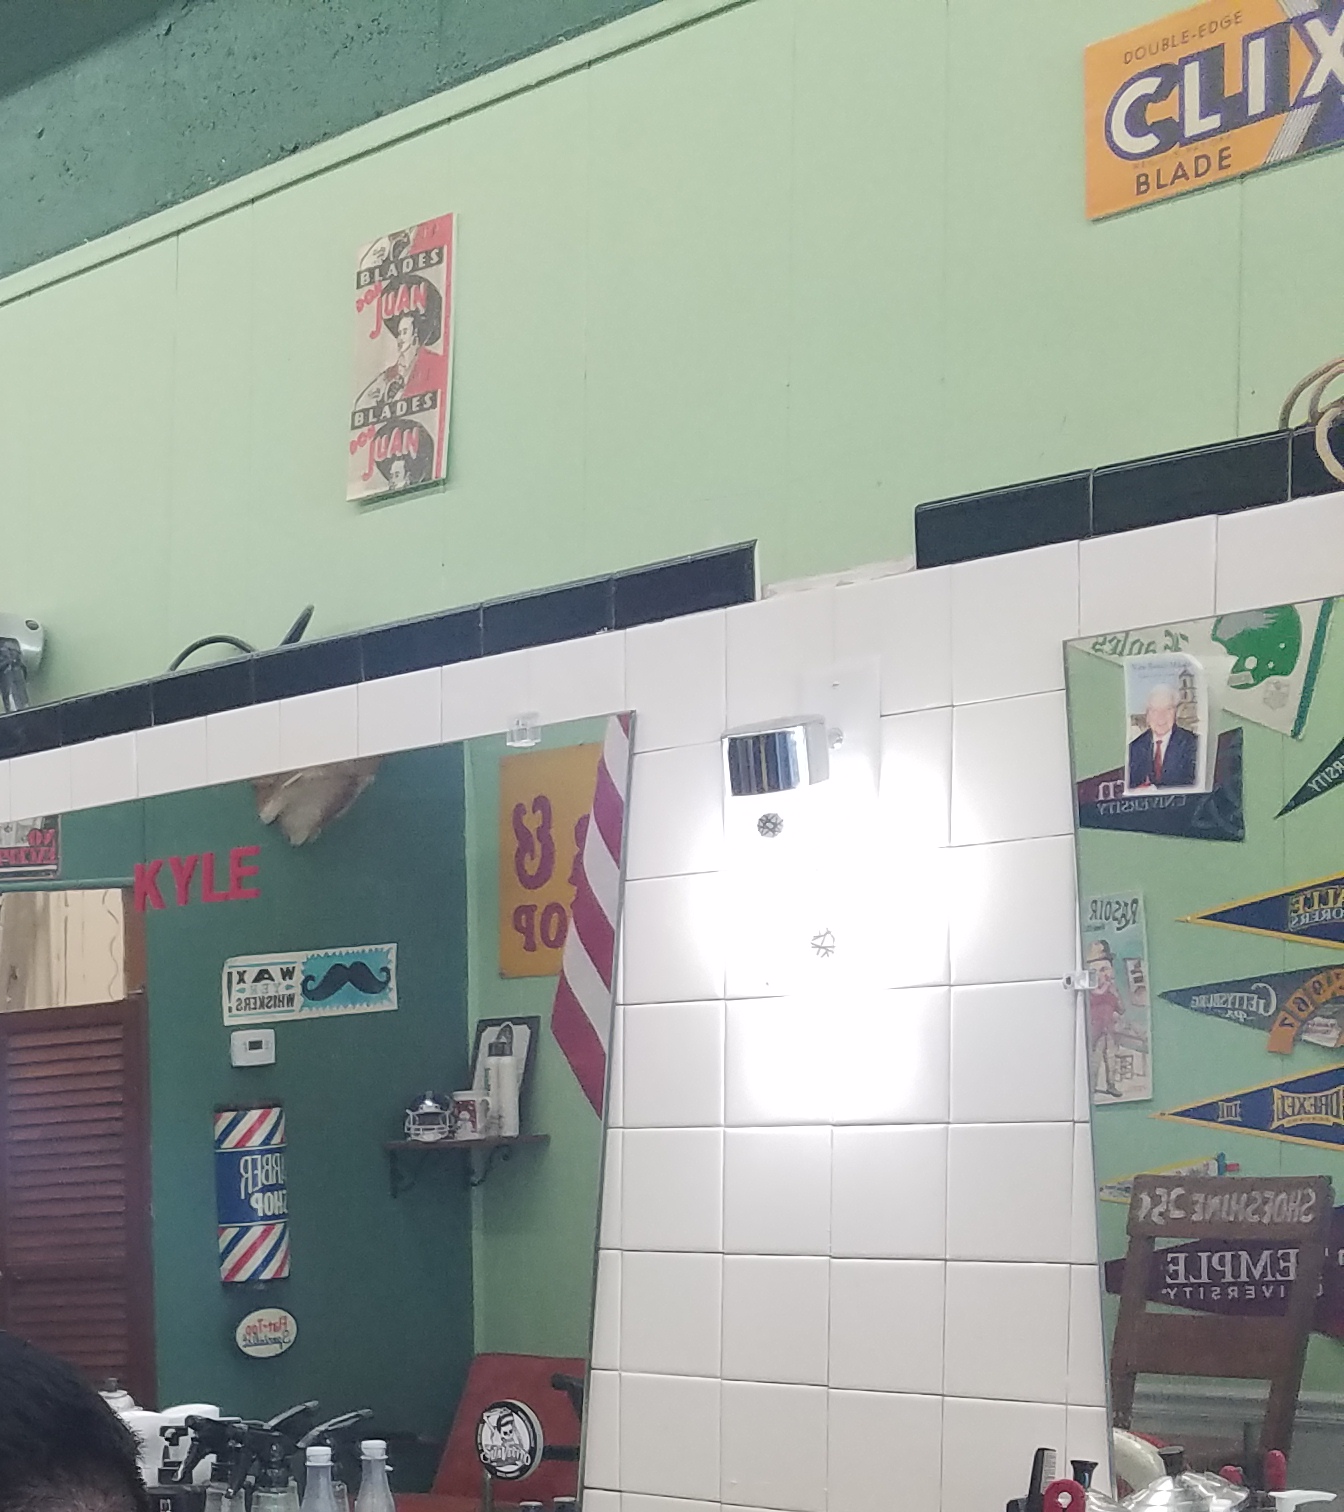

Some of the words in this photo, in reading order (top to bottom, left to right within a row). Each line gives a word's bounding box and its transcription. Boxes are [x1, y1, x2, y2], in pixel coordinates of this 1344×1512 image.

[1123, 11, 1243, 65] DOUBLE-EDGE
[1110, 11, 1344, 154] CLIX
[1135, 146, 1232, 196] BLADE
[359, 248, 440, 286] BLADES
[369, 281, 429, 339] JUAN
[354, 392, 433, 427] BLADES
[362, 427, 420, 482] JUAN
[133, 845, 261, 912] KYLE
